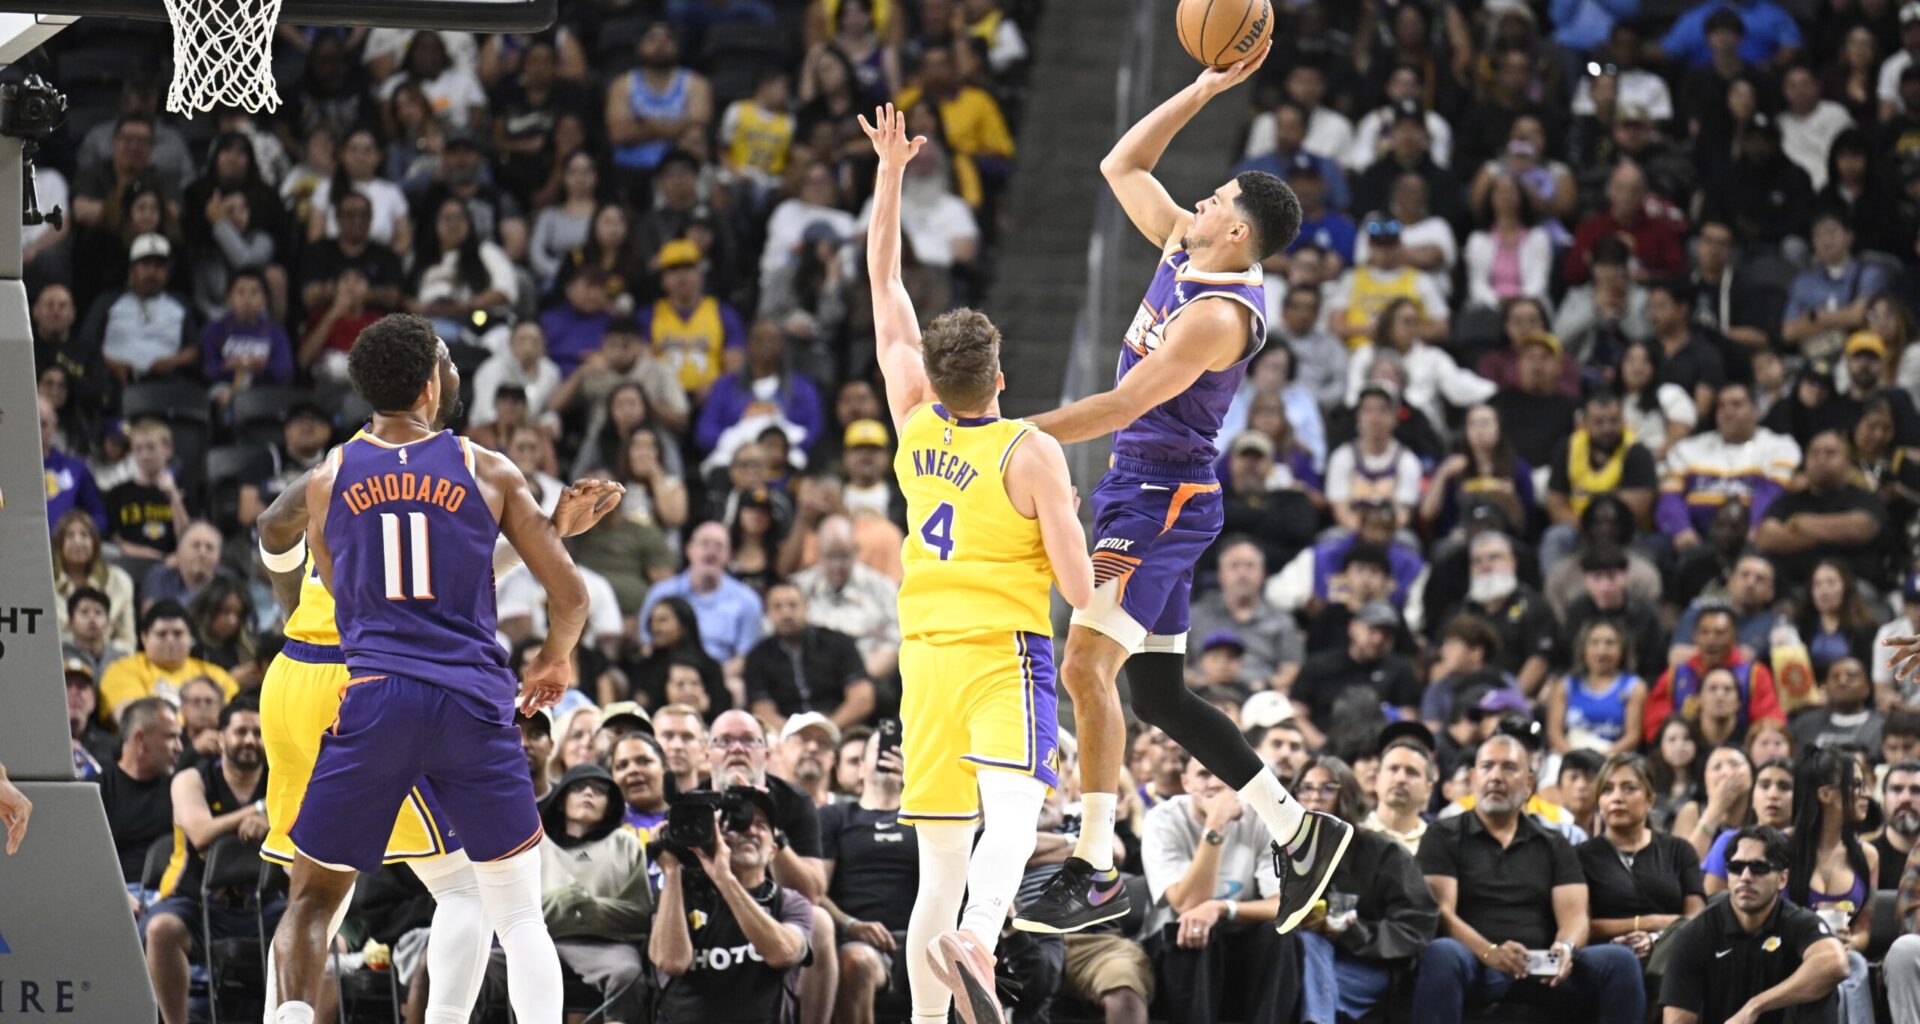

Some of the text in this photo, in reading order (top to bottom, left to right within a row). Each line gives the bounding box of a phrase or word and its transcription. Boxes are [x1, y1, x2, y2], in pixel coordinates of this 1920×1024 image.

[1234, 0, 1270, 54] Wilson
[342, 472, 467, 516] IGHODARO
[912, 448, 979, 492] KNECHT
[379, 511, 436, 601] 11
[920, 501, 955, 561] 4
